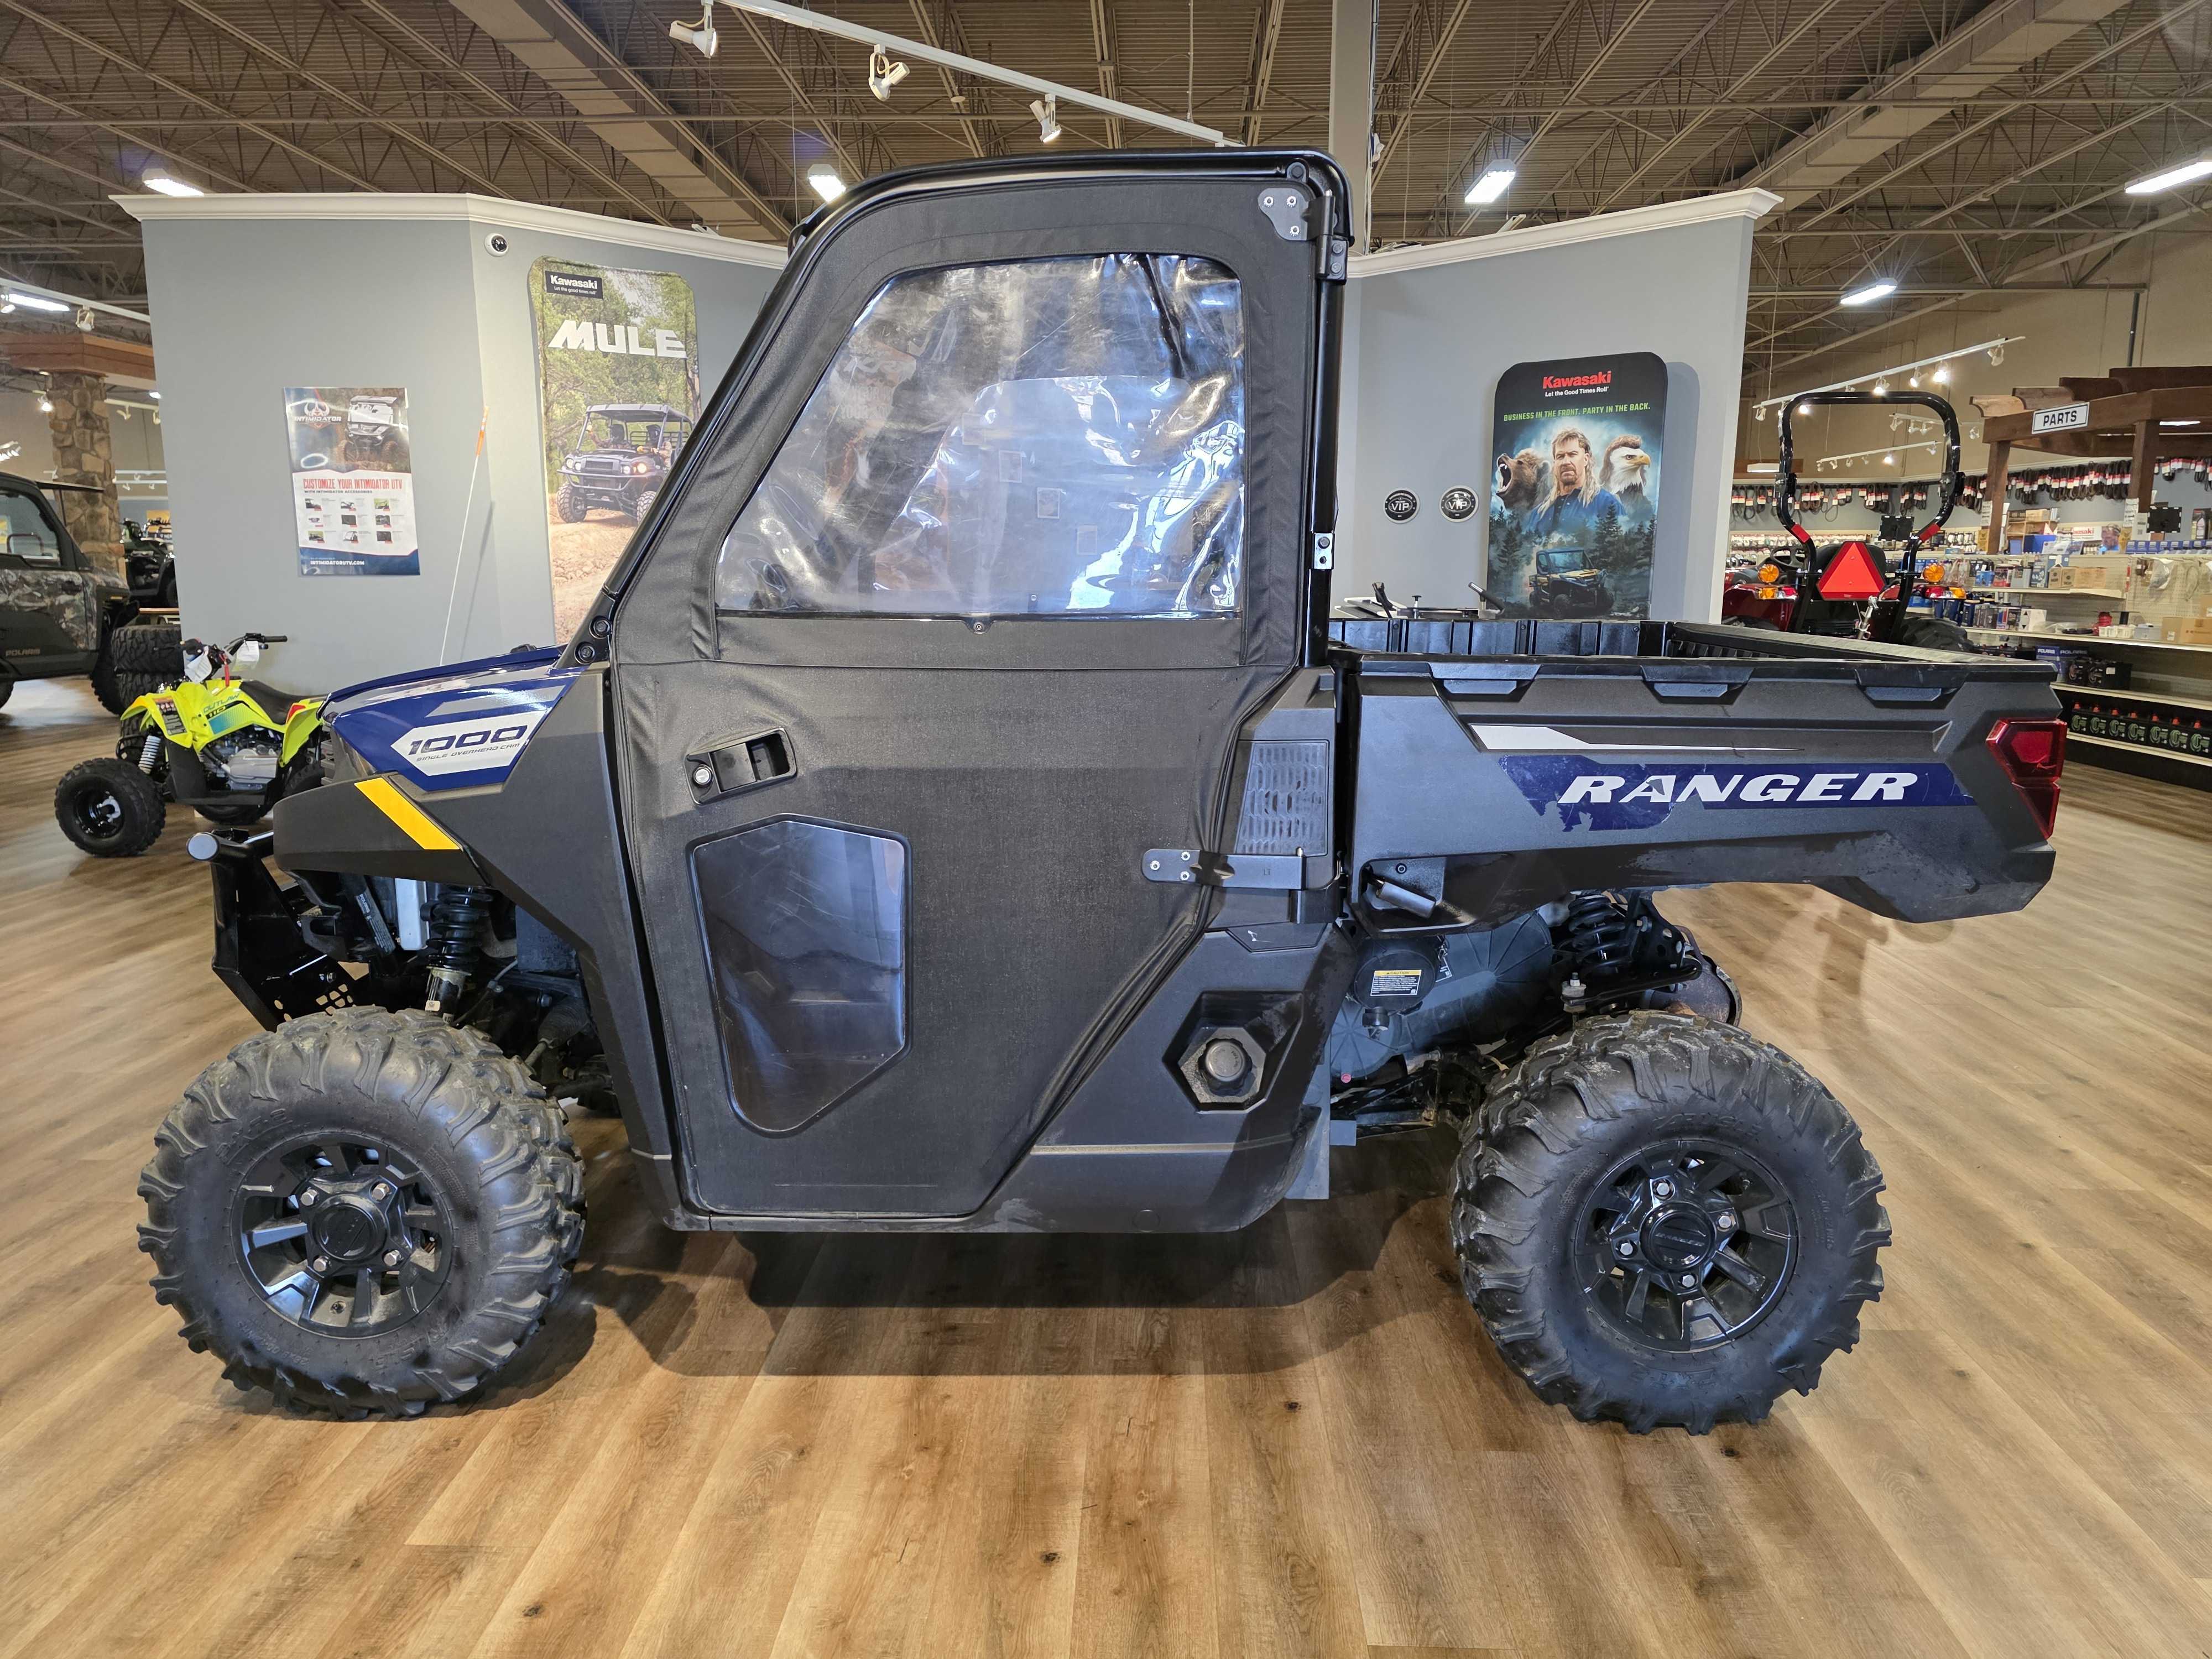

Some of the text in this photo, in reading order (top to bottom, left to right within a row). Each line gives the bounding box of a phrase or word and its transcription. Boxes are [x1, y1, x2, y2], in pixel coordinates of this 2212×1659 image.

[550, 275, 598, 289] Kawasaki
[547, 320, 688, 359] MULE
[1542, 371, 1612, 389] Kawasaki
[1504, 412, 1535, 421] BUSINESS
[1558, 408, 1580, 416] FRONT.
[1583, 406, 1604, 415] PARTY
[1630, 402, 1651, 411] BACK.
[2043, 410, 2077, 426] PARTS
[303, 478, 403, 489] CUSTOMIZE YOUR INTIMIDATOR UTV
[1391, 502, 1410, 511] VIP
[203, 693, 240, 713] OUTLAW
[408, 725, 528, 756] 1000
[416, 753, 447, 762] SINGLE
[451, 747, 498, 757] OVERHEAD
[1557, 772, 1918, 804] RANGER
